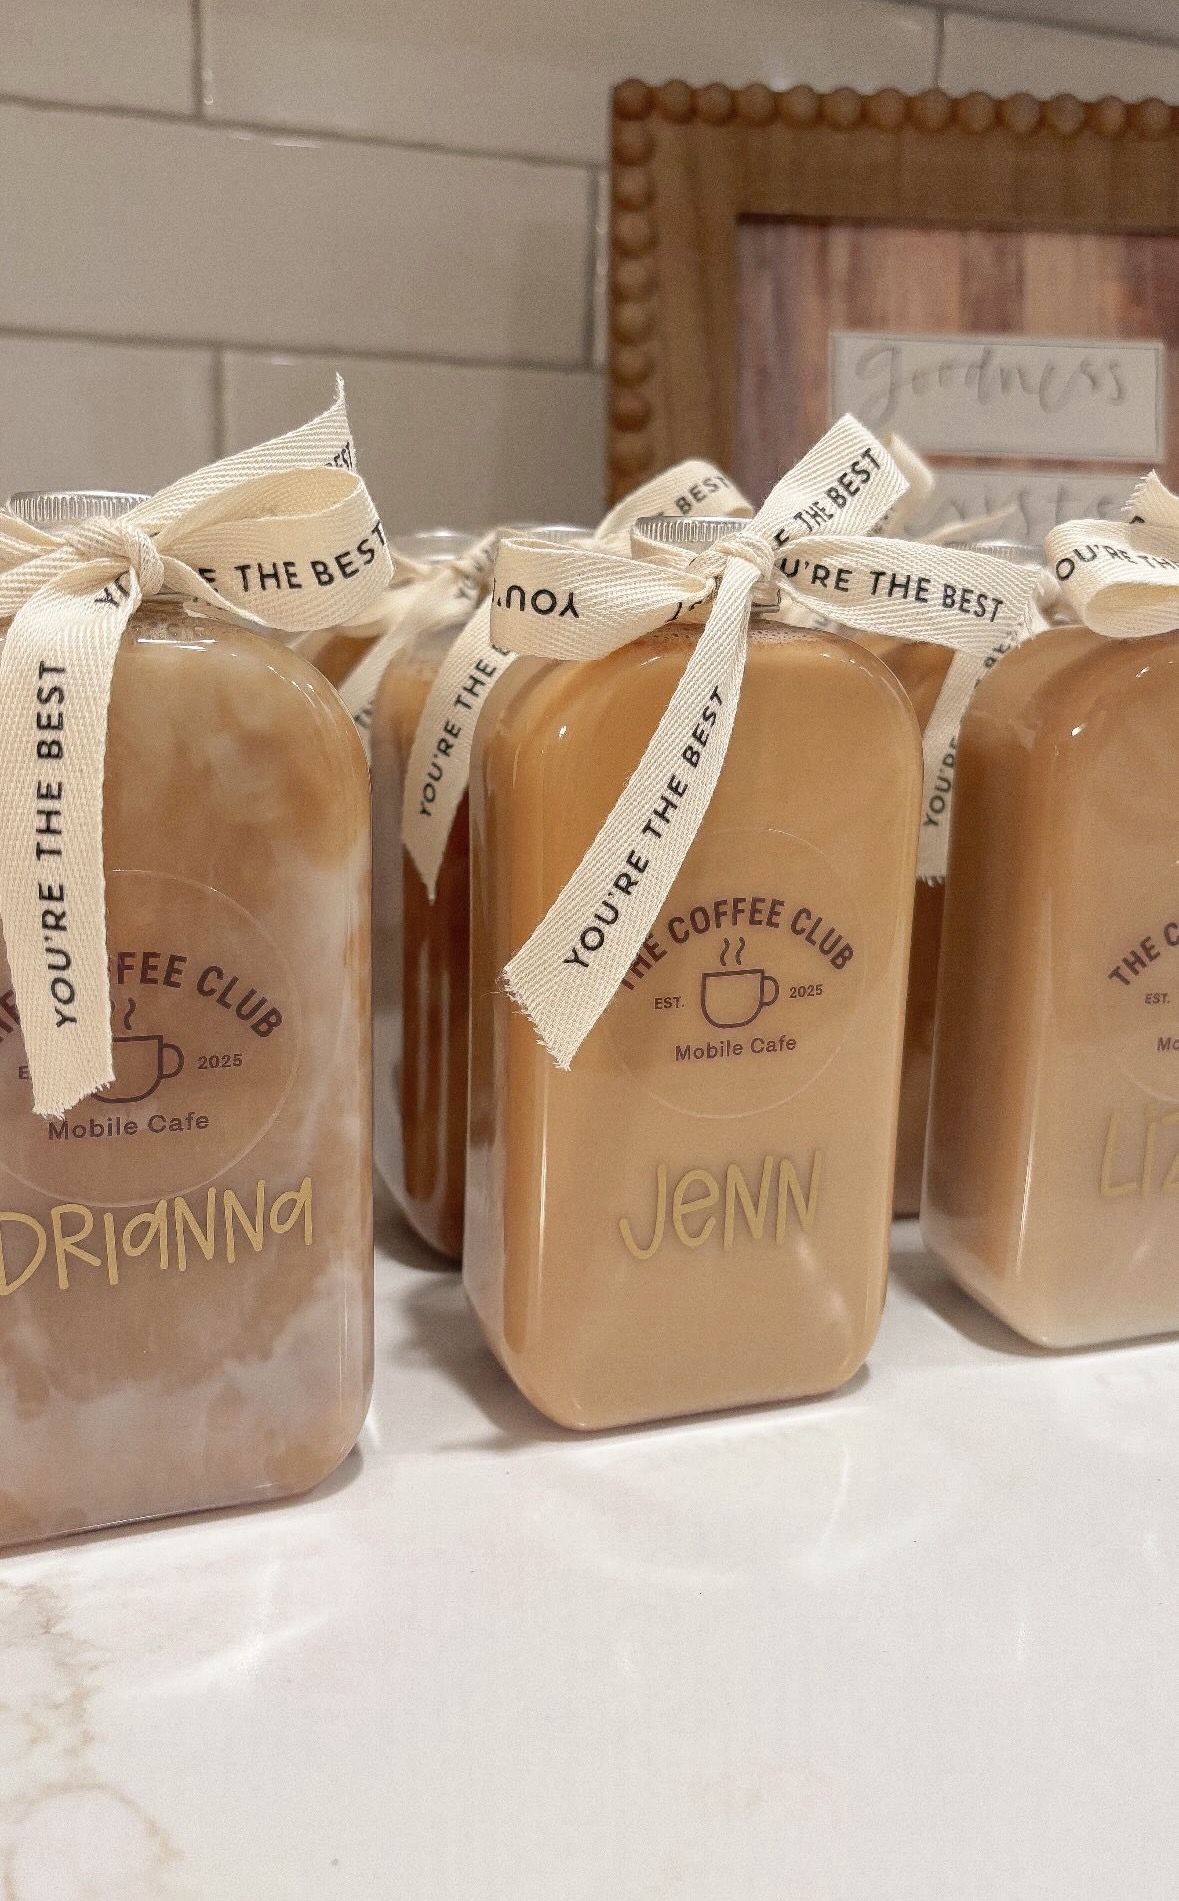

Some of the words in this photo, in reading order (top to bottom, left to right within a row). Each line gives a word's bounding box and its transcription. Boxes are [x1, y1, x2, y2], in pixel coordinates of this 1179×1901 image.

[324, 440, 352, 470] EST
[674, 476, 729, 516] BEST
[793, 500, 834, 533] THE
[831, 448, 881, 509] BEST
[235, 561, 302, 593] THE
[310, 521, 386, 587] BEST
[1056, 545, 1138, 581] OU'RE
[1138, 555, 1179, 569] TH
[493, 579, 580, 619] YOU'
[780, 557, 852, 592] U'RE
[870, 570, 931, 603] THE
[942, 583, 1003, 622] BEST
[37, 661, 66, 760] BEST
[419, 719, 462, 817] YOU'RE
[455, 658, 497, 711] THE
[36, 781, 64, 861] THE
[563, 849, 650, 969] YOU'RE
[642, 775, 688, 839] THE
[682, 685, 723, 768] BEST
[40, 881, 78, 1028] YOU'RE
[667, 897, 785, 944] COFFEE
[790, 907, 854, 970] CLUB
[1108, 935, 1161, 985] THE
[107, 950, 188, 989] FEE
[196, 965, 283, 1038] CLUB
[654, 996, 685, 1010] EST.
[789, 983, 824, 999] 2025
[1145, 992, 1171, 1004] EST.
[197, 1053, 244, 1070] 2025
[675, 1043, 744, 1061] Mobile
[750, 1035, 798, 1053] Cafe
[48, 1117, 139, 1141] Mobile
[147, 1111, 210, 1134] Cafe
